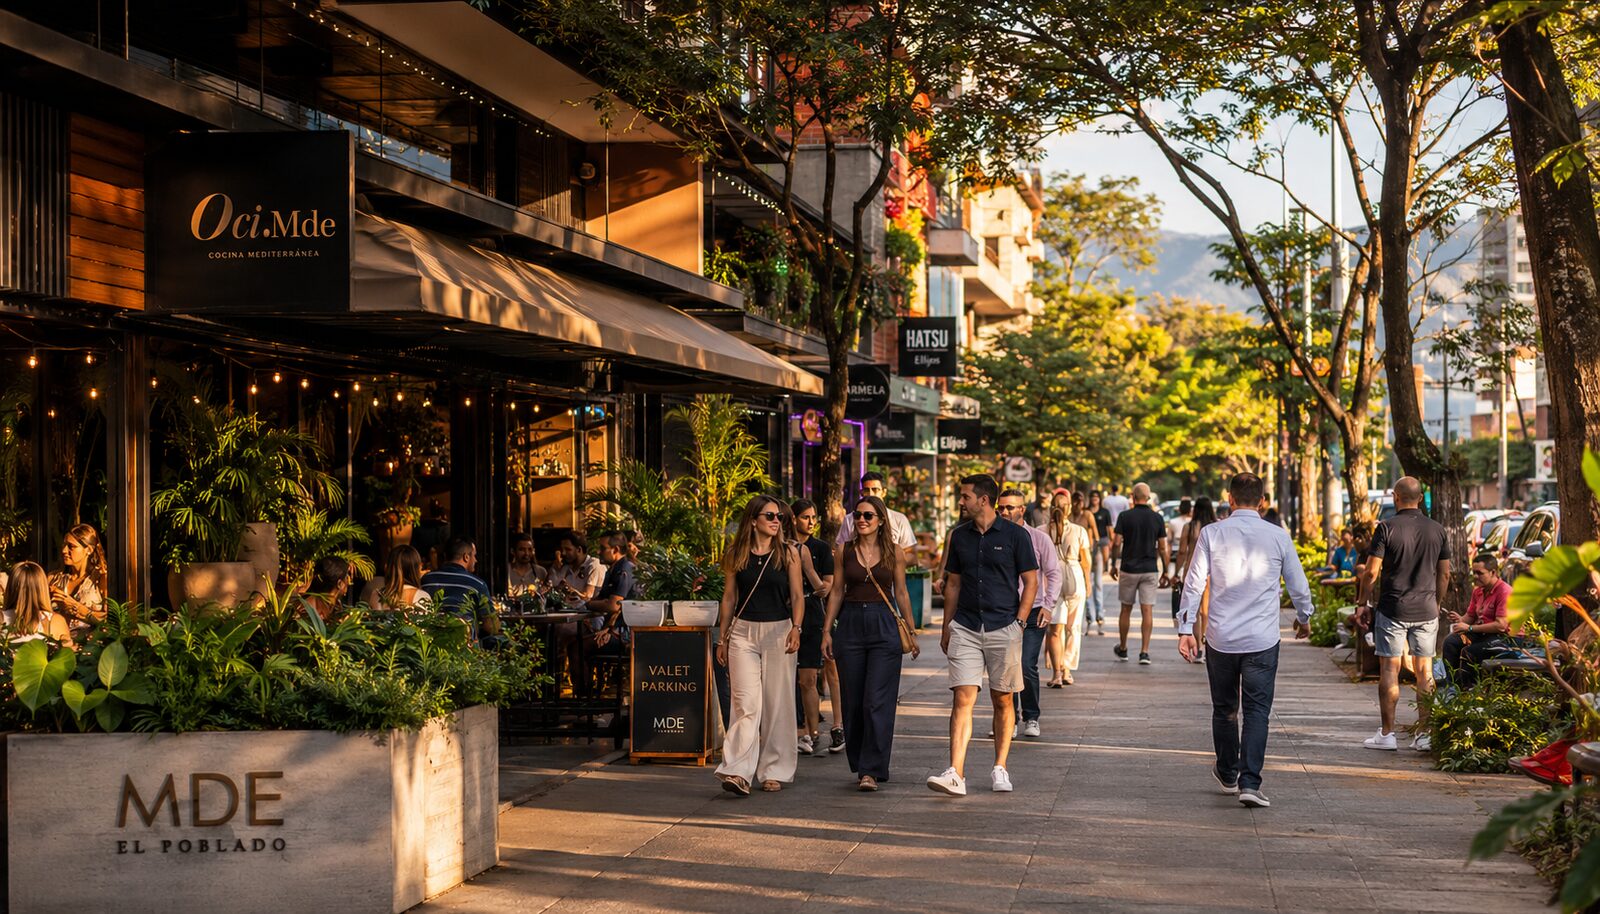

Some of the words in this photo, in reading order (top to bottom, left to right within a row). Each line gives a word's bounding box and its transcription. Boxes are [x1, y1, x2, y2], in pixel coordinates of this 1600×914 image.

[191, 193, 336, 241] Oci.Mde
[208, 251, 244, 259] COCINA
[906, 329, 949, 348] HATSU
[649, 665, 690, 677] VALET
[641, 681, 697, 692] PARKING
[653, 717, 685, 729] MDE
[117, 771, 284, 828] MDE
[116, 840, 146, 855] EL
[161, 838, 286, 854] POBLADO
